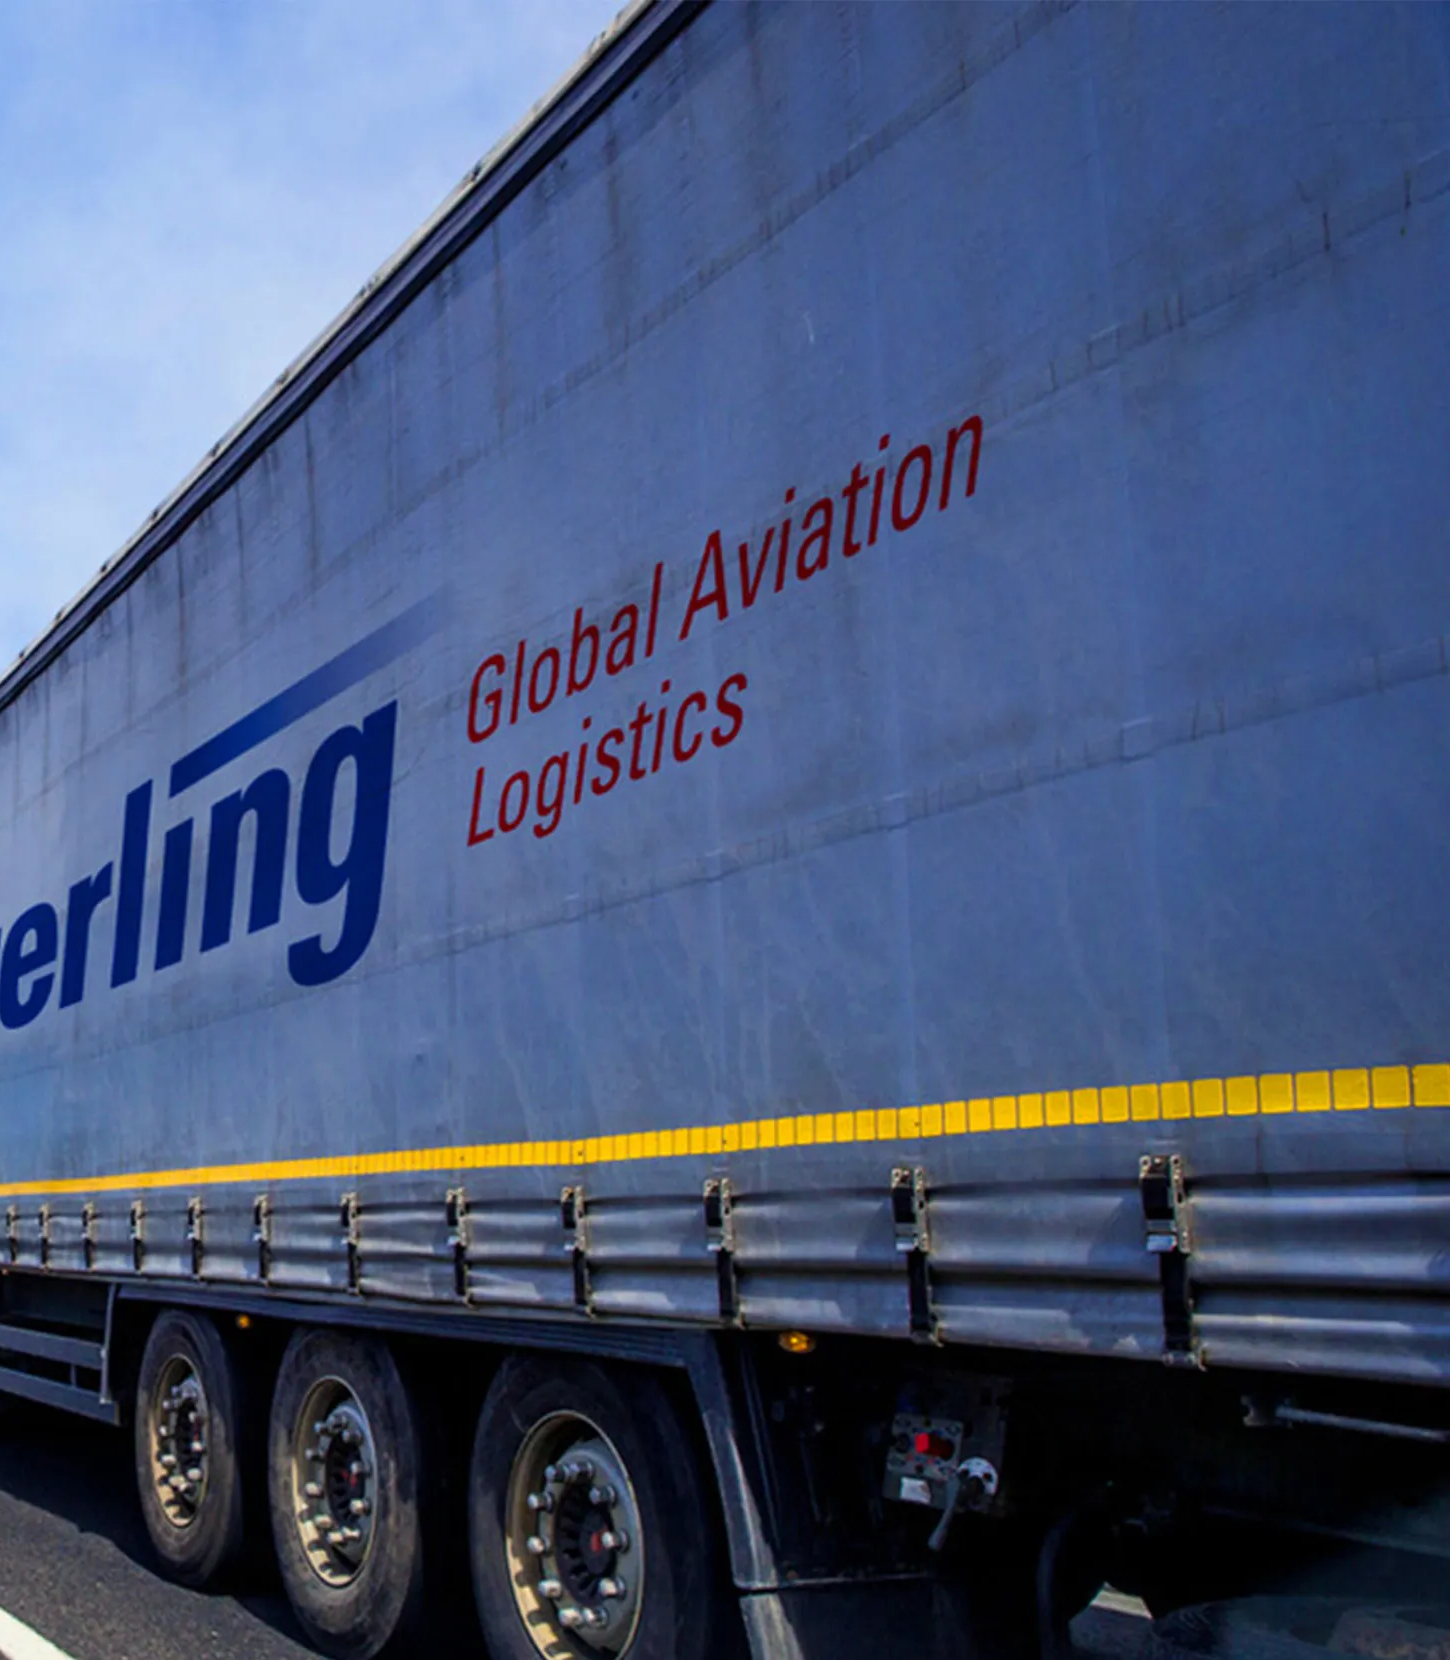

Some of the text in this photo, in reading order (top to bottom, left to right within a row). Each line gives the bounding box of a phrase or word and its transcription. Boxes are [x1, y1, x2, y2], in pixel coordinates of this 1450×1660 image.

[467, 415, 983, 744] Global Aviation
[467, 673, 747, 847] Logistics
